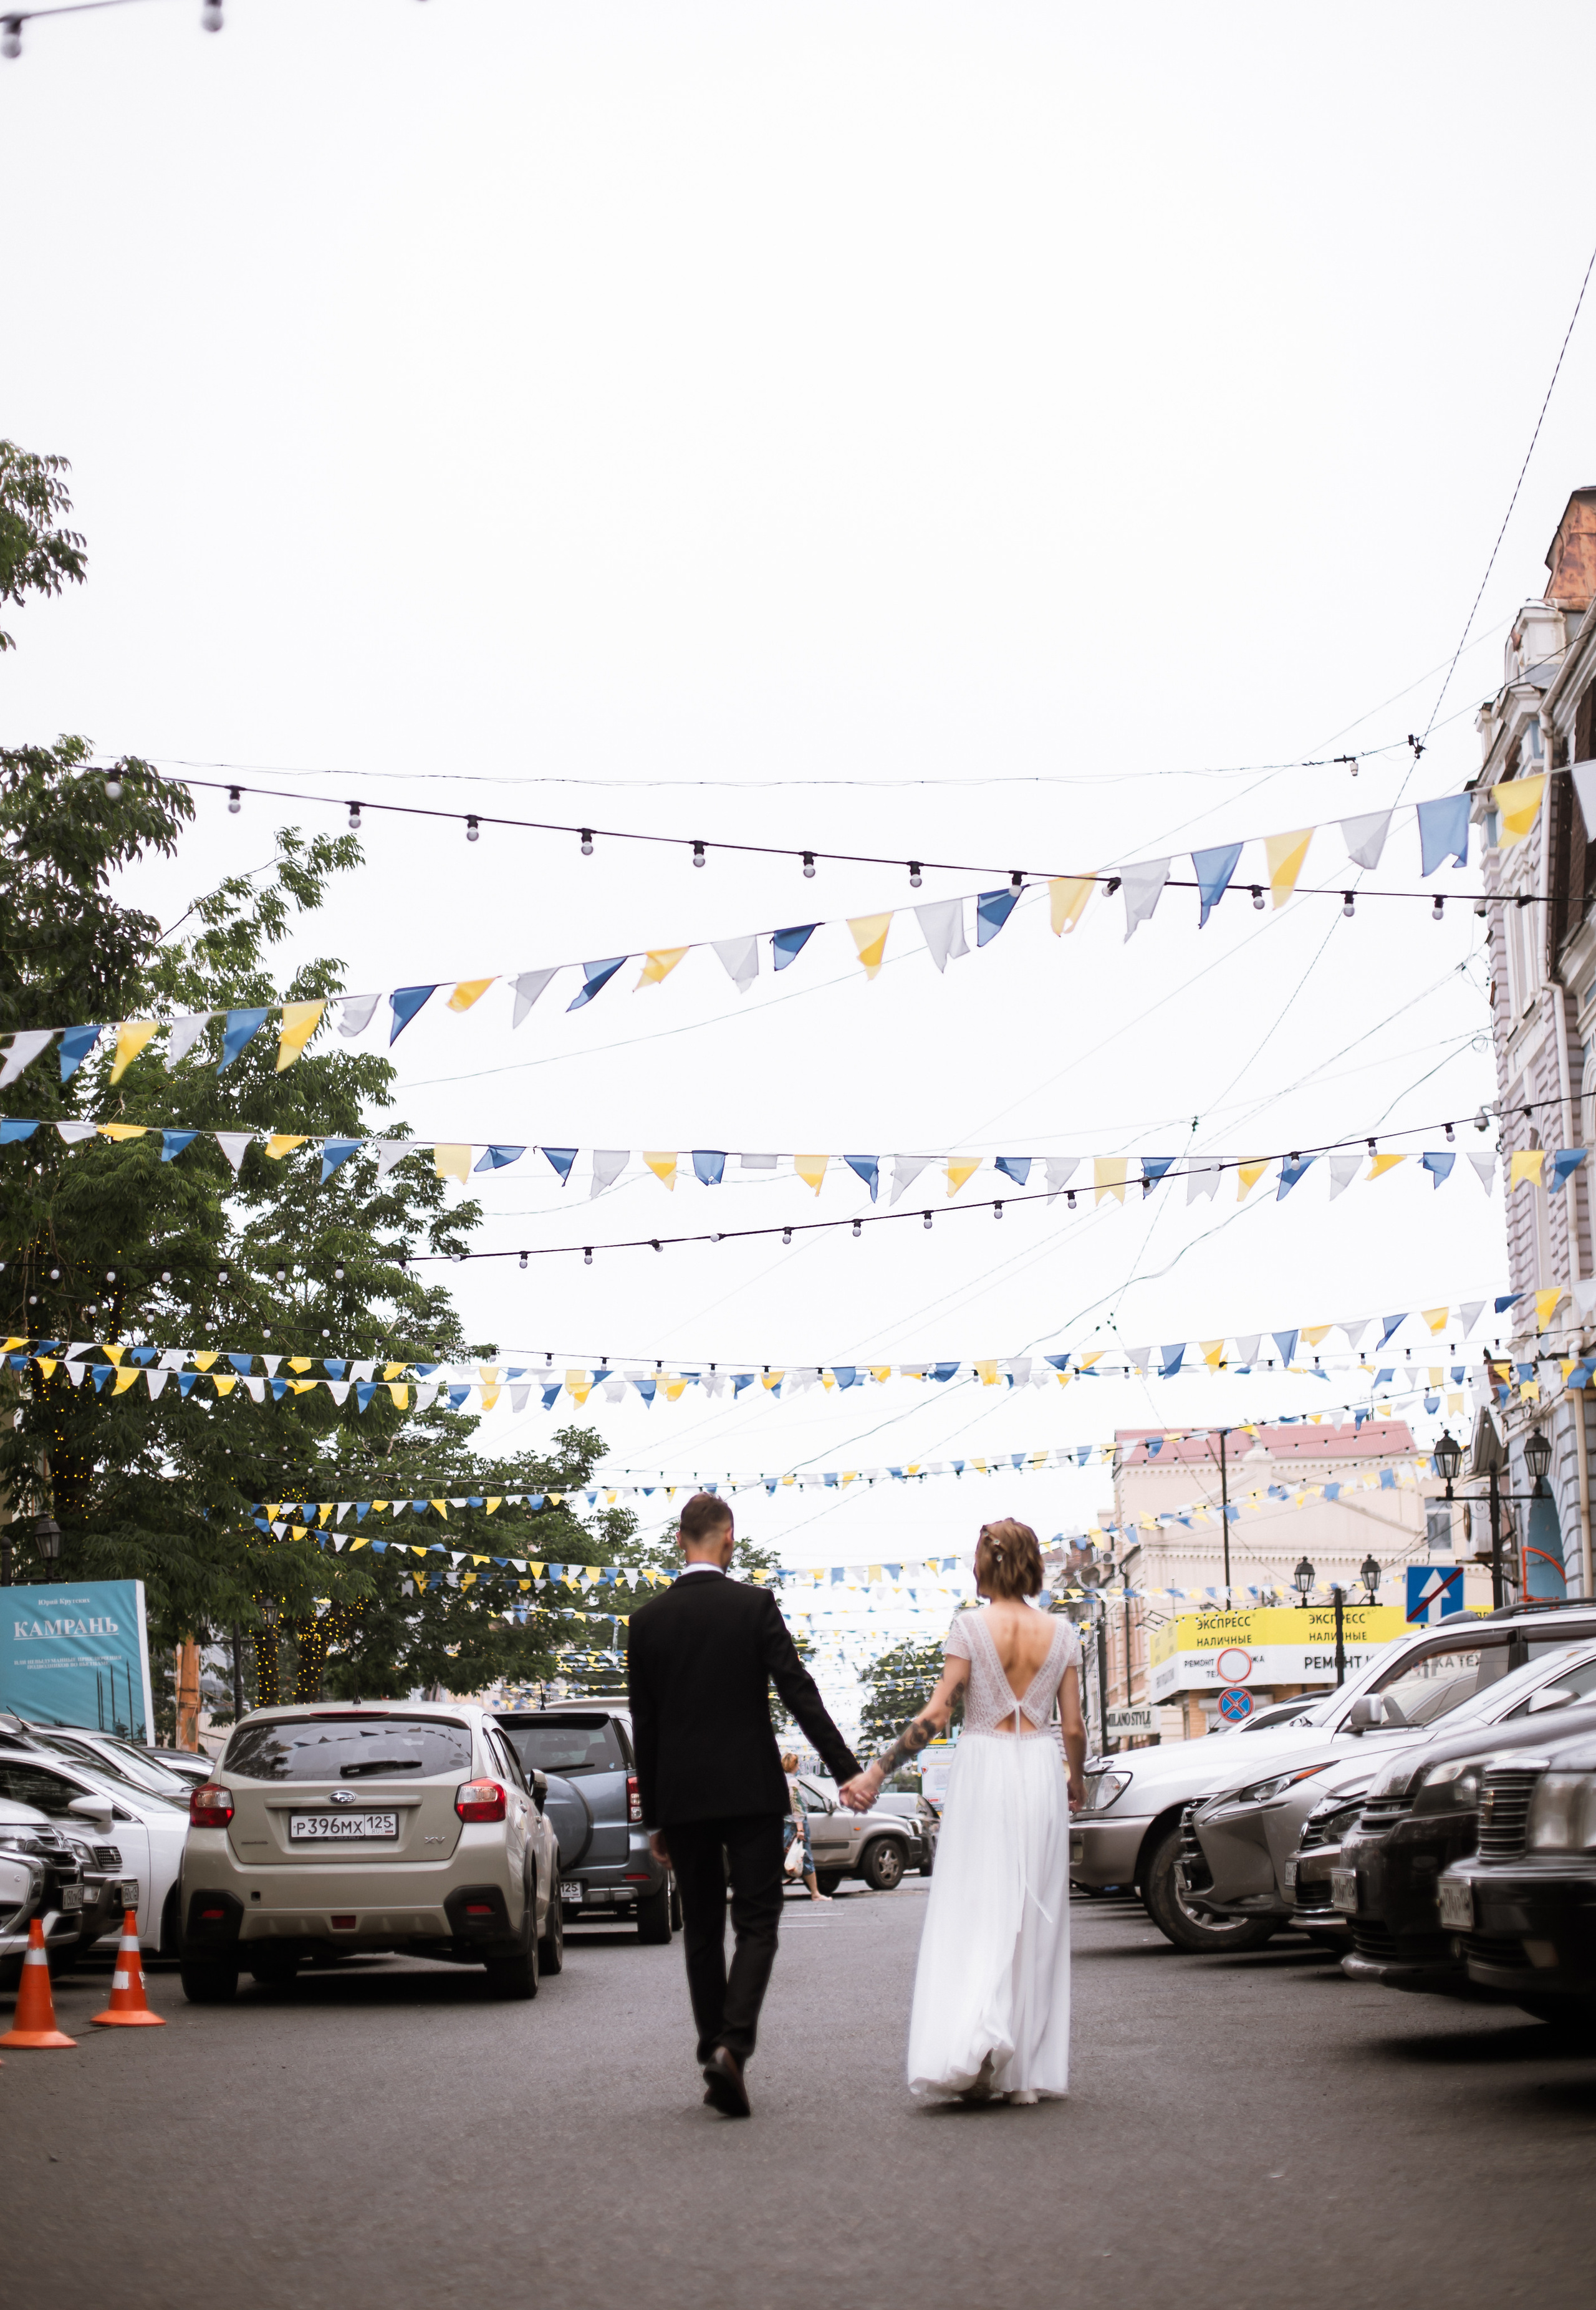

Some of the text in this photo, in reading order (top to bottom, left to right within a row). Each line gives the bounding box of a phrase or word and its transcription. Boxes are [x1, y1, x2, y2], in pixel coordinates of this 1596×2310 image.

[38, 1598, 90, 1607] Юрий Крутских
[14, 1617, 118, 1638] КАМРАНЬ
[1197, 1616, 1251, 1630] ЭКСПРЕСС
[1197, 1635, 1252, 1647] НАЛИЧНЫЕ
[1309, 1632, 1367, 1641] НАЛИНЫЕ
[1184, 1658, 1214, 1668] РЕМОНТ
[1304, 1656, 1362, 1669] РЕМНТ
[1131, 1710, 1151, 1725] STYLE
[367, 1816, 392, 1829] 125
[424, 1836, 446, 1844] XV
[560, 1883, 578, 1892] 125
